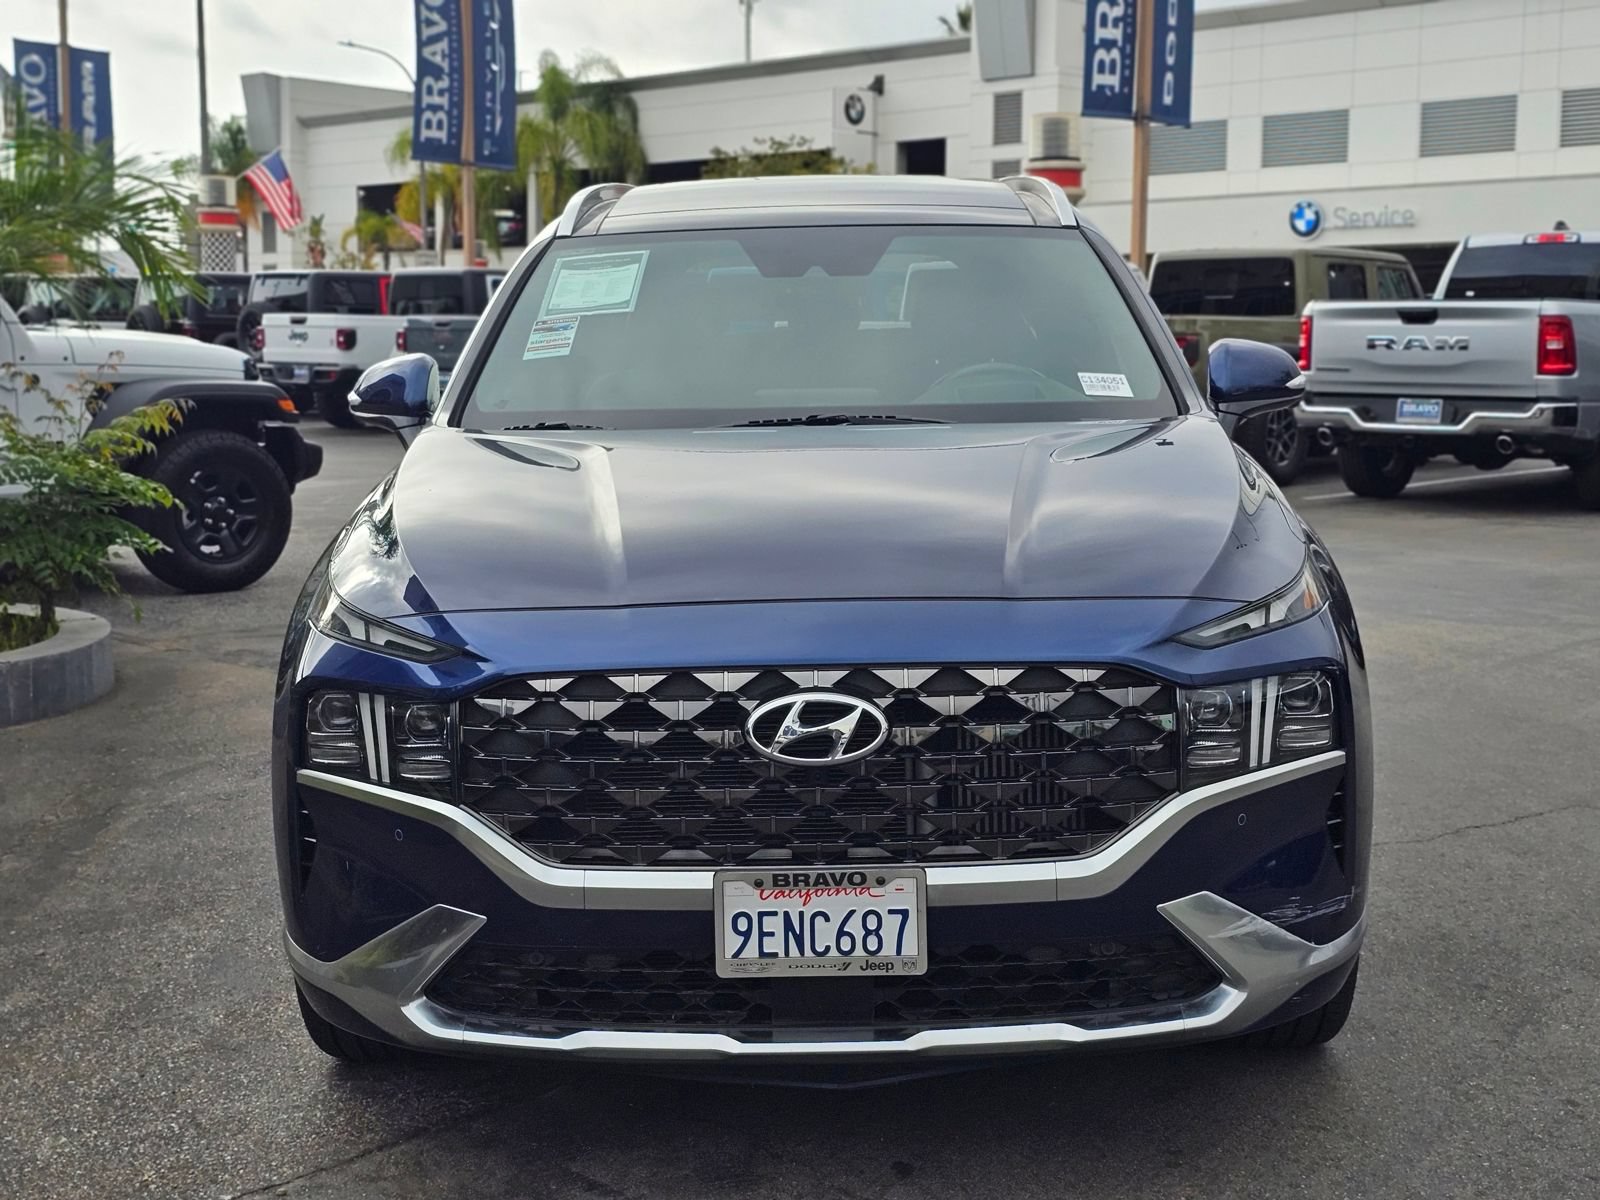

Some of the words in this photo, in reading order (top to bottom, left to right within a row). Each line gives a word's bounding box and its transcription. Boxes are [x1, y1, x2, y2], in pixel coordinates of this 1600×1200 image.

[420, 0, 449, 145] BRAV
[1333, 205, 1416, 228] Service
[288, 329, 309, 342] Jeep
[1365, 335, 1470, 351] RAM
[772, 871, 868, 888] BRAVO
[731, 908, 910, 959] 9ENC687
[860, 959, 894, 973] Jeep
